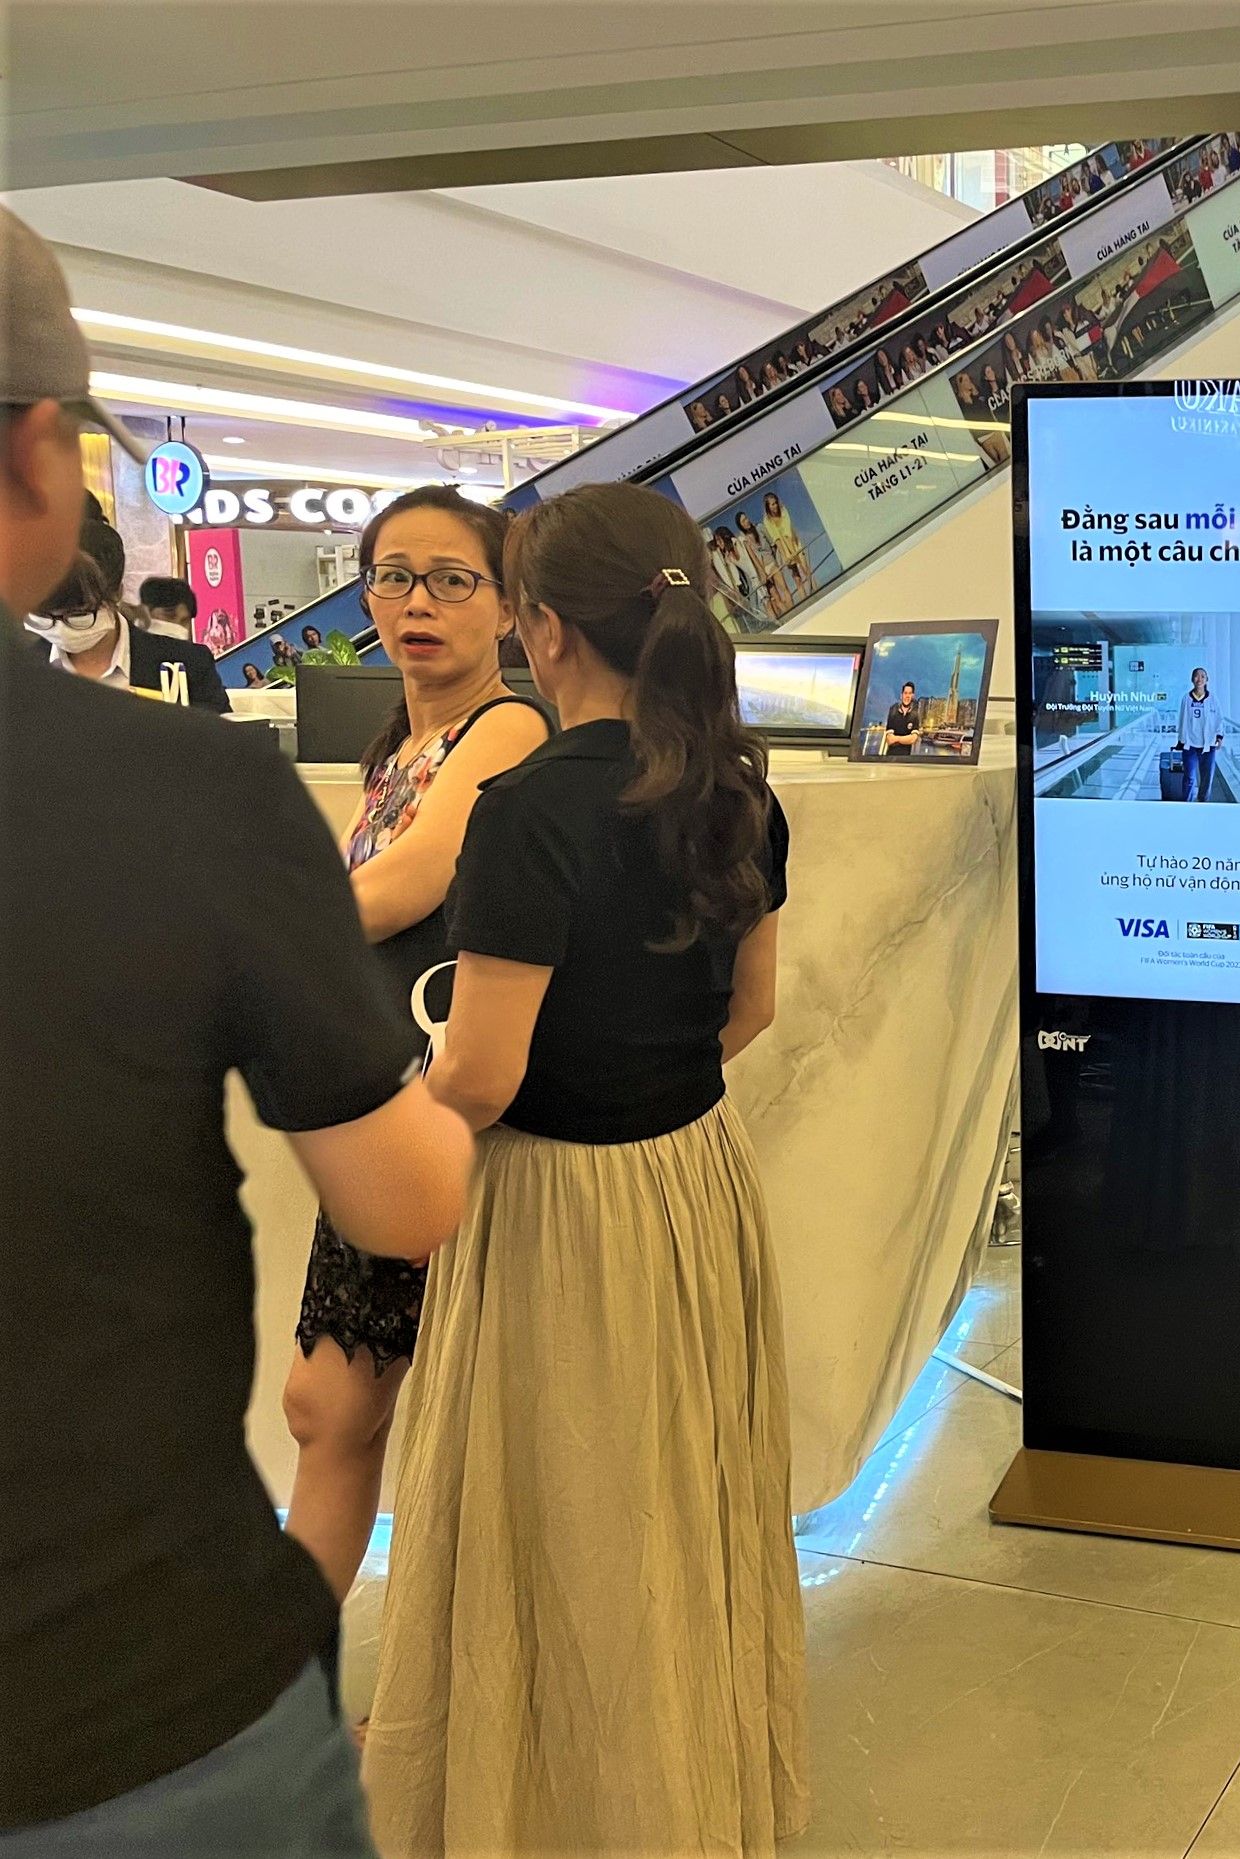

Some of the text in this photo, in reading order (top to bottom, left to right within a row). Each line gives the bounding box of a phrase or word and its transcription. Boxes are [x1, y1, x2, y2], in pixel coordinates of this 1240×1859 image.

[1061, 504, 1129, 535] Đằng
[1135, 513, 1179, 530] sau
[1186, 503, 1235, 530] mỗi
[1072, 540, 1093, 562] là
[1099, 540, 1152, 567] một
[1158, 540, 1203, 562] câu
[1090, 691, 1129, 704] Huỳnh
[1193, 708, 1201, 719] 9
[1137, 855, 1156, 871] Tự
[1160, 855, 1188, 870] hào
[1192, 857, 1212, 870] 20
[1101, 872, 1129, 889] ủng
[1132, 874, 1152, 890] hộ
[1155, 876, 1176, 888] nữ
[1180, 876, 1206, 892] vận
[1115, 918, 1169, 938] VISA
